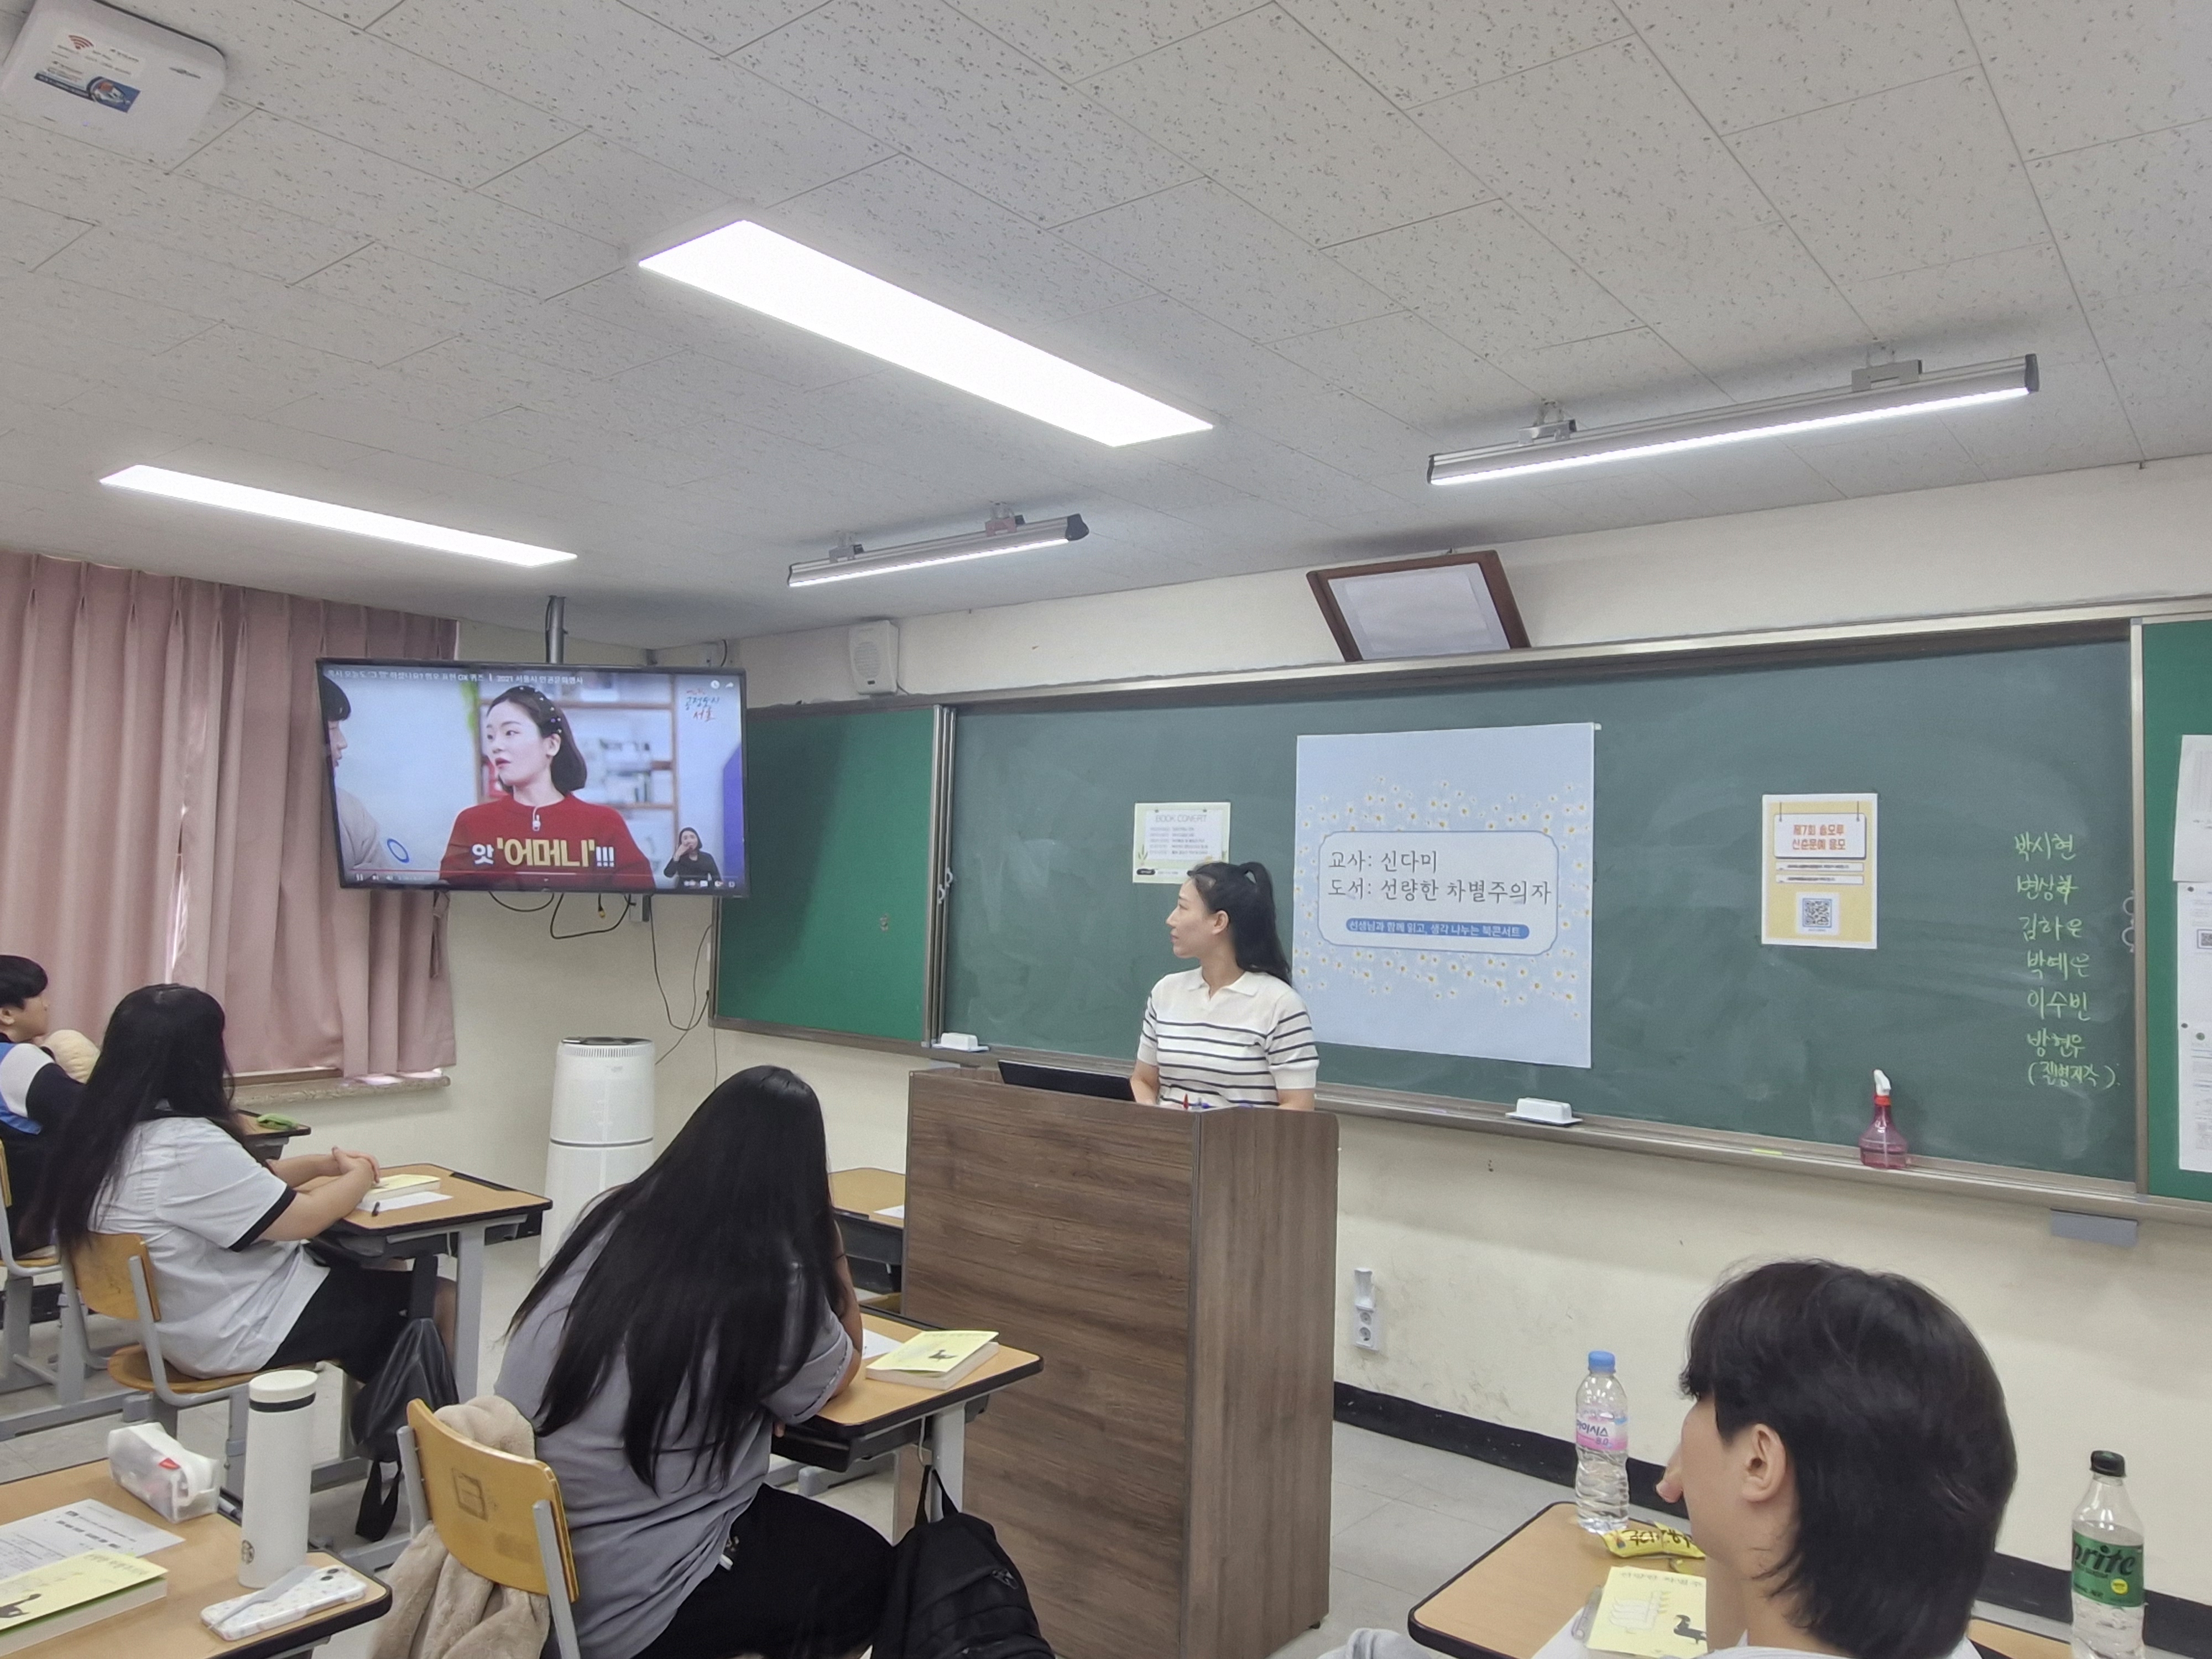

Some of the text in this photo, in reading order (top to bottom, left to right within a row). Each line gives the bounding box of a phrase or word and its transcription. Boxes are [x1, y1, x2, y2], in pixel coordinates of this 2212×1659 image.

[1156, 814, 1176, 823] BOOK
[472, 844, 494, 865] 앗
[2015, 831, 2077, 862] 박시현
[1328, 850, 1437, 874] 교사: 신다미
[1328, 877, 1552, 905] 도서: 선량한 차별주의자
[1349, 920, 1384, 932] 선생님과
[1387, 921, 1405, 932] 함께
[1430, 923, 1448, 935] 생각
[1451, 924, 1480, 936] 나누는
[1483, 925, 1521, 937] 북콘서트
[2027, 949, 2090, 981] 박예은
[2027, 986, 2091, 1021] 이수빈
[2027, 1027, 2086, 1059] 방현우
